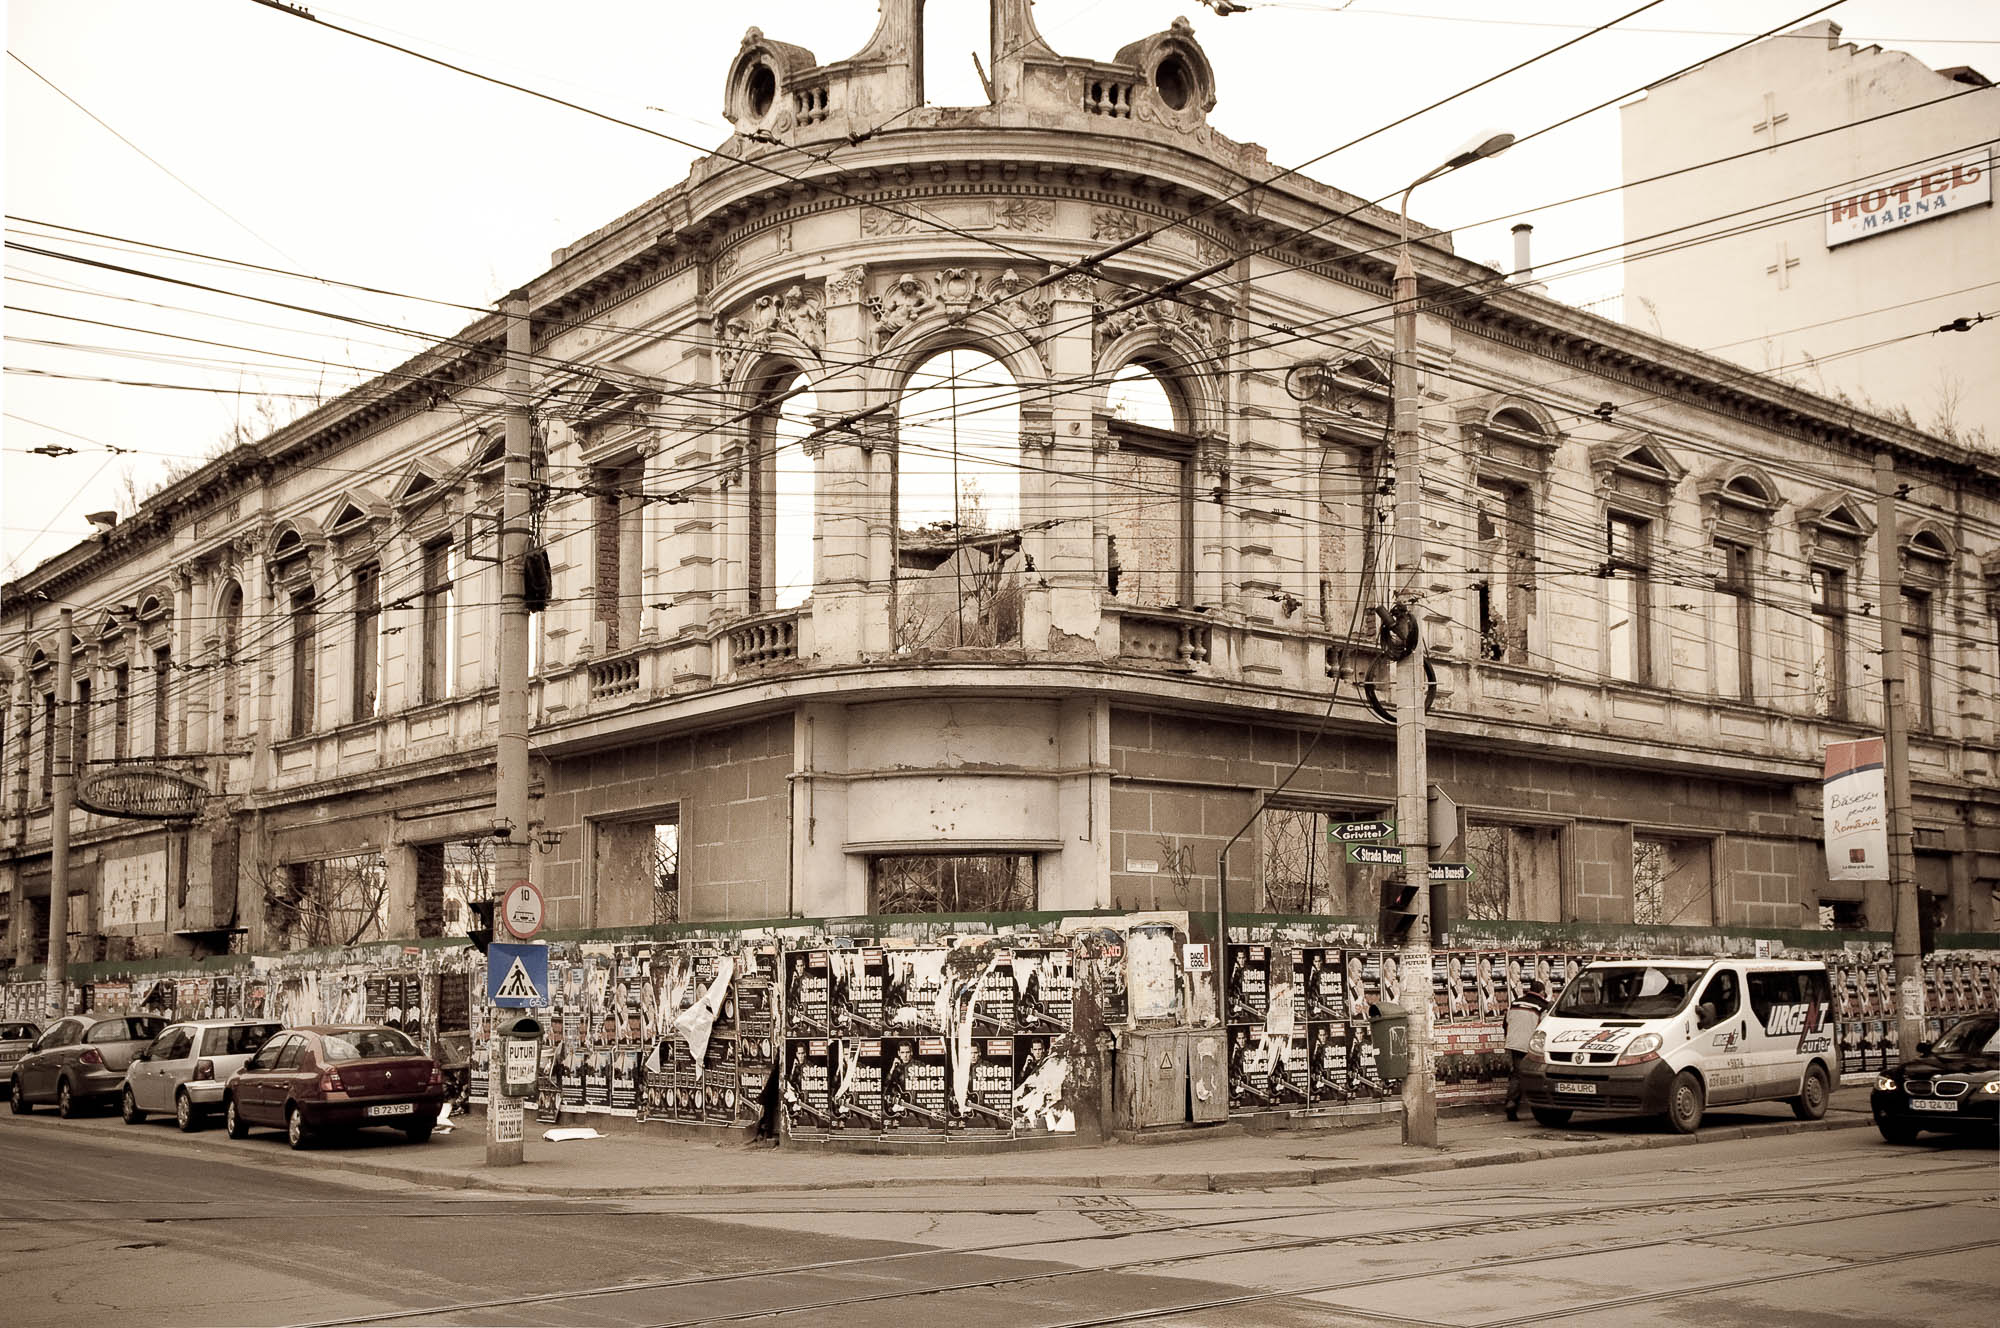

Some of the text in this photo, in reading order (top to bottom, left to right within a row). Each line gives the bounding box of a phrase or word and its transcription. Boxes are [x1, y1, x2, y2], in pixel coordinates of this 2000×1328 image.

[1832, 162, 1982, 225] HOTEL
[1862, 194, 1947, 231] MARNA
[1346, 824, 1377, 832] Calea
[1361, 848, 1402, 863] Strada Berzei
[520, 889, 530, 901] 10
[1421, 914, 1430, 934] 5
[1766, 1002, 1830, 1037] URGENT
[509, 1046, 536, 1059] PUTURI
[1800, 1037, 1831, 1054] curier
[1578, 1084, 1594, 1092] URC
[373, 1107, 380, 1115] B
[382, 1106, 392, 1114] 72
